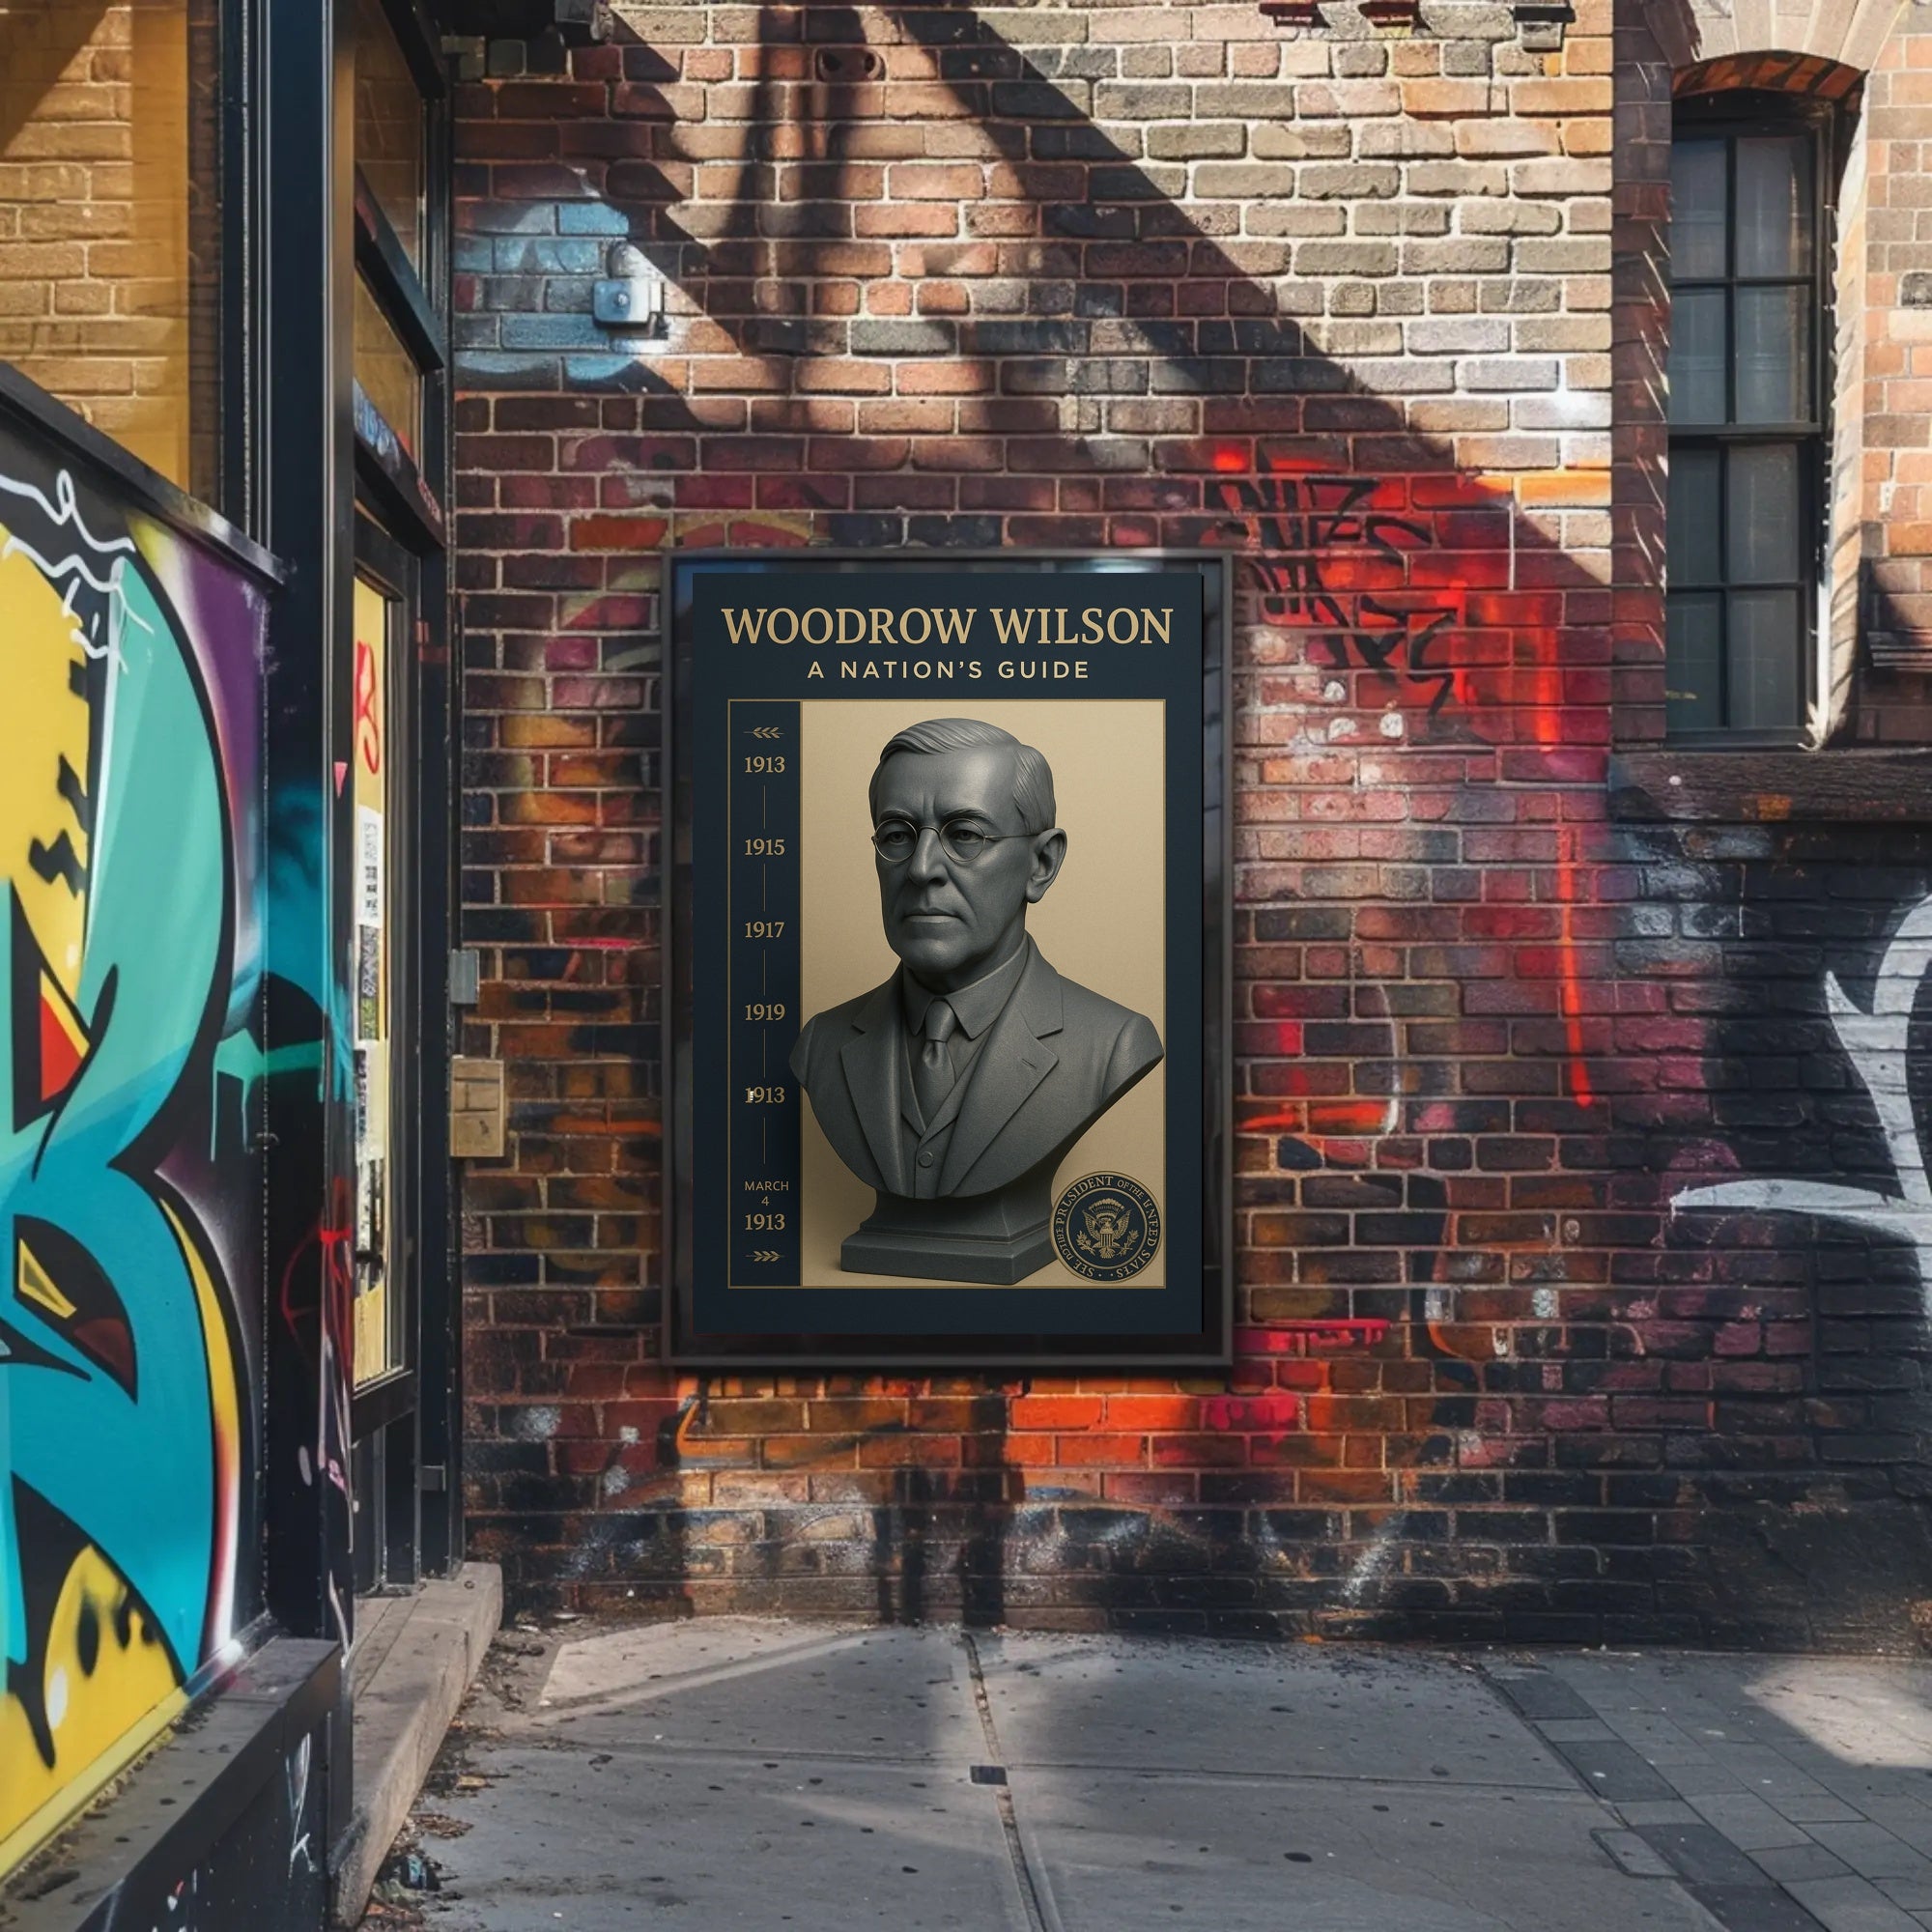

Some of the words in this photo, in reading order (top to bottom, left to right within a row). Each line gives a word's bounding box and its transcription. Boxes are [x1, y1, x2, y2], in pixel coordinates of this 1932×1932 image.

[721, 608, 978, 644] WOODROW
[989, 608, 1174, 644] WILSON
[807, 661, 825, 679] A
[840, 661, 982, 679] NATION'S
[998, 661, 1089, 679] GUIDE
[744, 756, 785, 774] 1913
[744, 838, 785, 856] 1915
[744, 922, 785, 938] 1917
[744, 1004, 785, 1021] 1919
[744, 1087, 785, 1103] 1913
[744, 1180, 789, 1191] MARCH
[760, 1196, 770, 1207] 4
[744, 1213, 785, 1231] 1913
